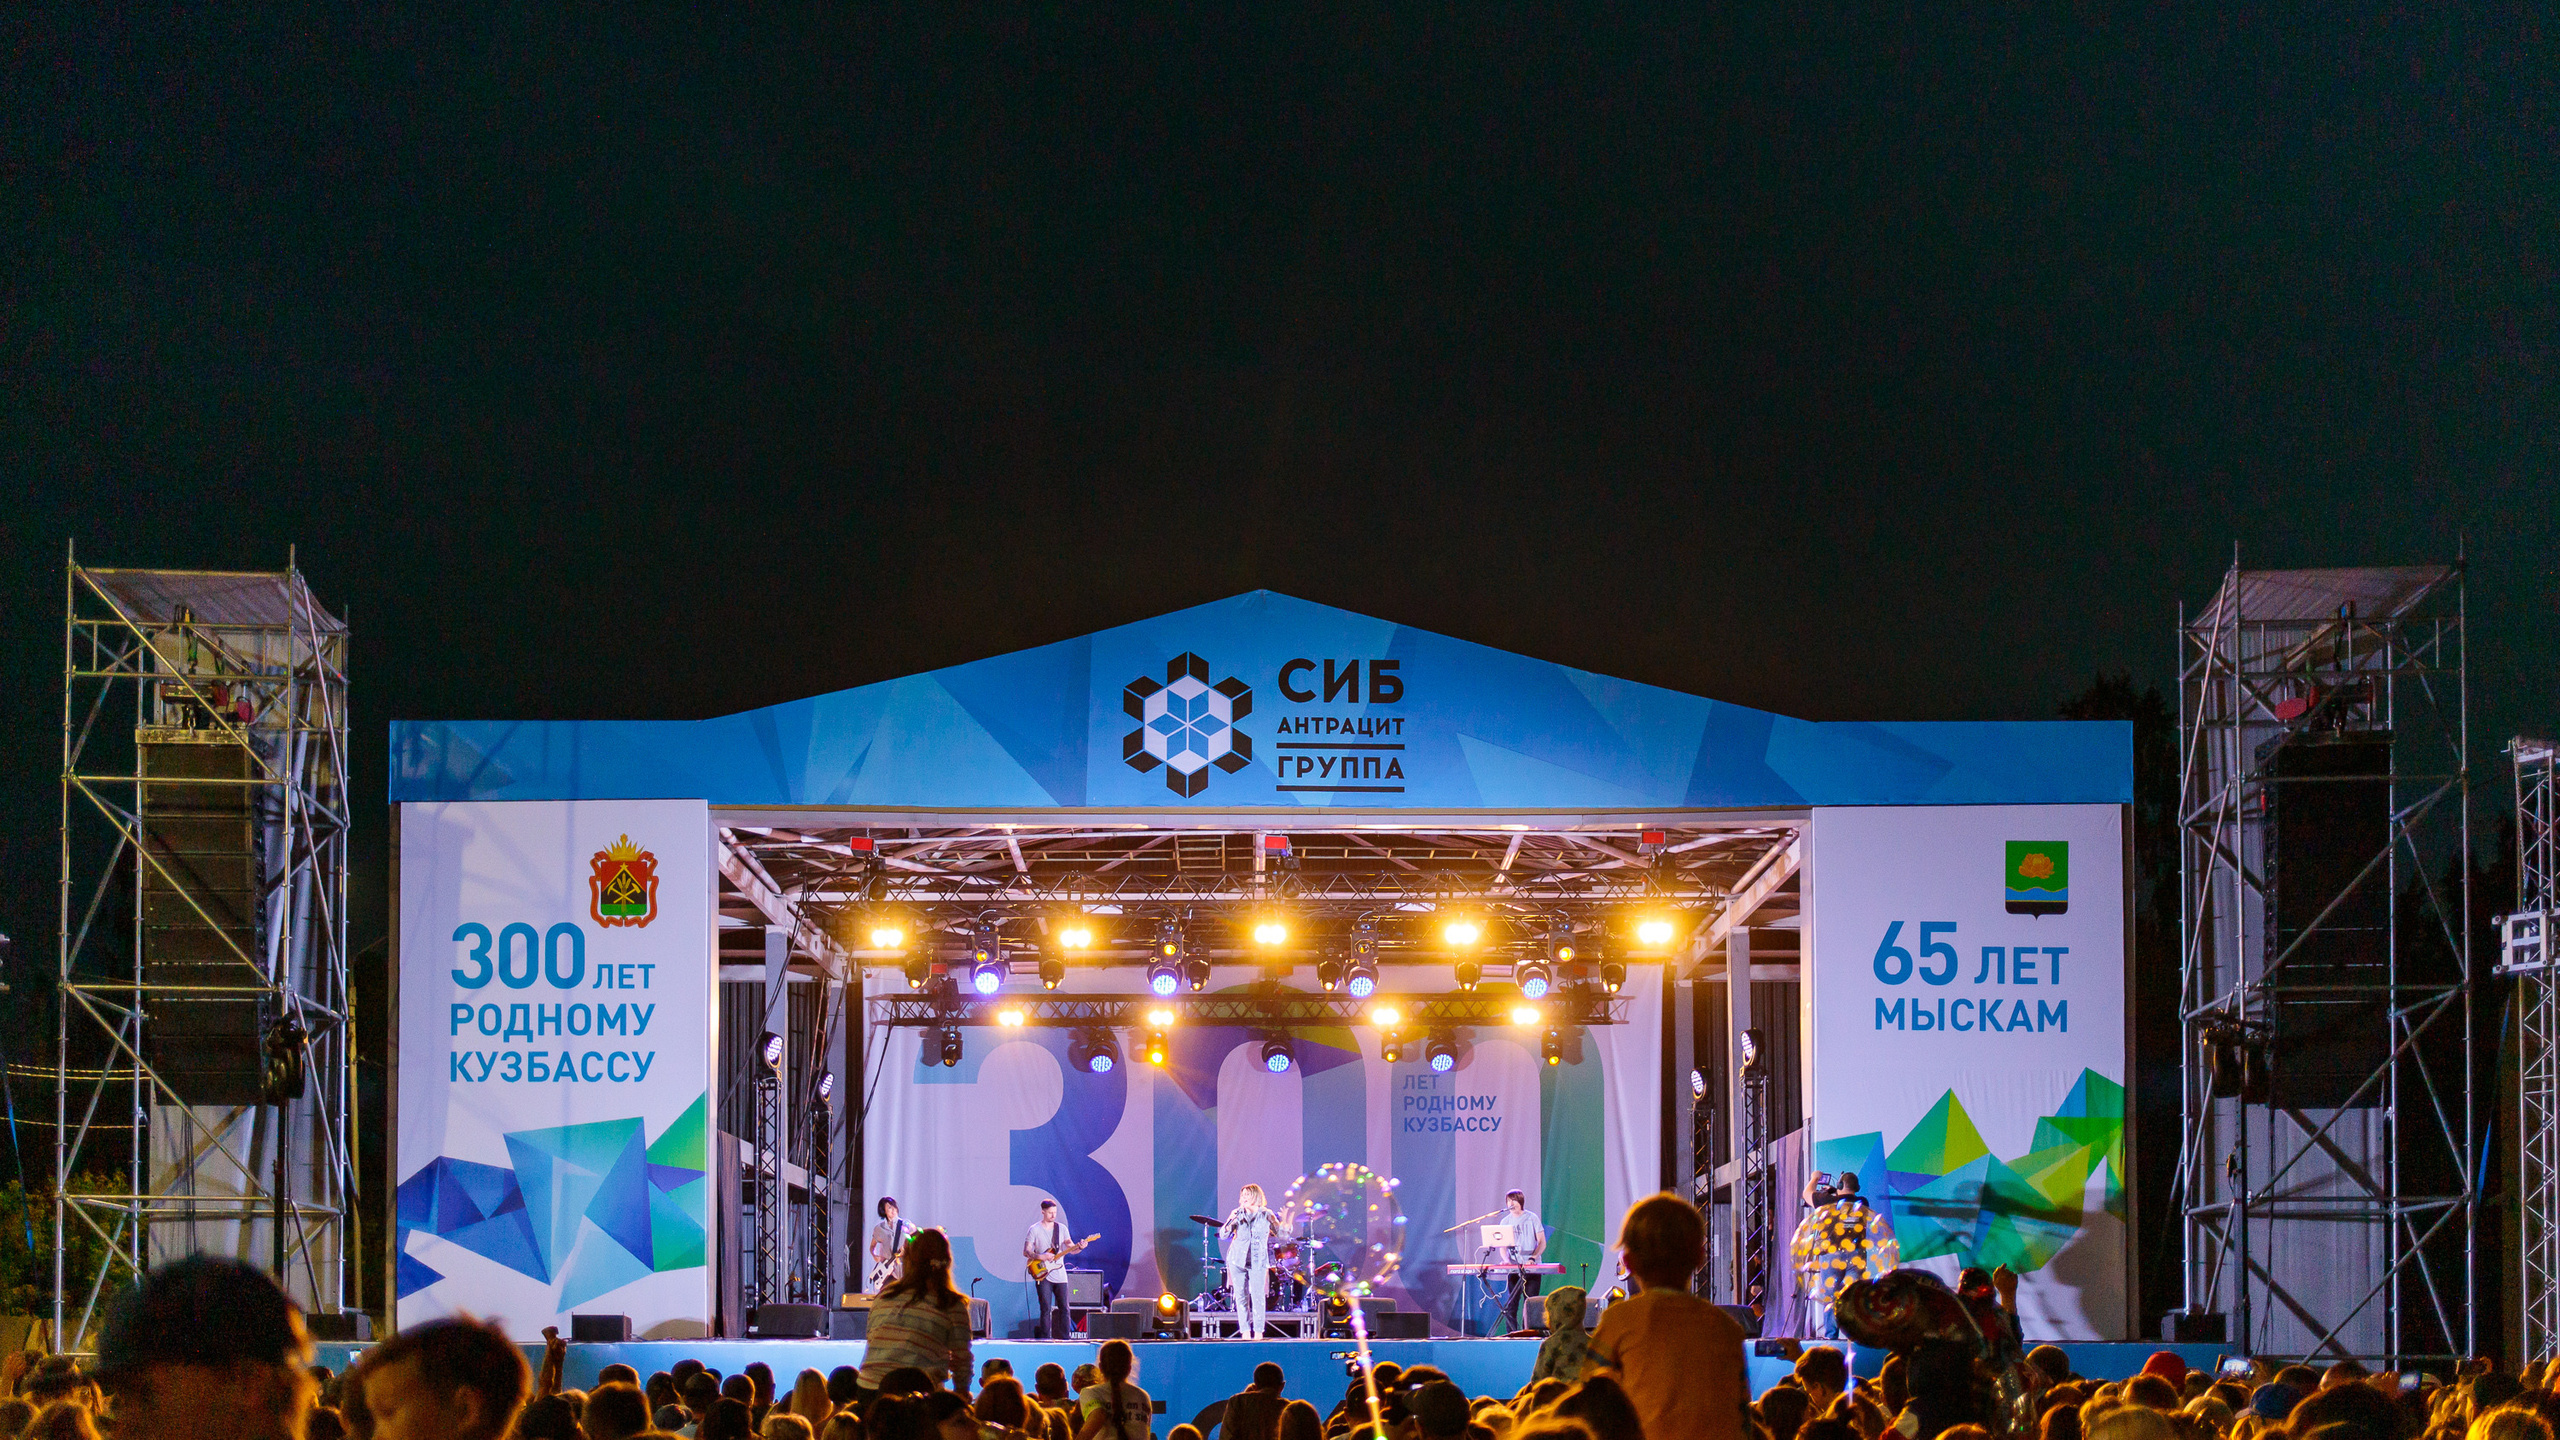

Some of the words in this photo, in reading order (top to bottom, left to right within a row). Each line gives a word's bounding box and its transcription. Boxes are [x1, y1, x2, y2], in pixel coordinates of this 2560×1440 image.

[1278, 658, 1404, 704] СИБ
[1277, 717, 1405, 738] АНТРАЦИТ
[1278, 757, 1405, 779] ГРУППА
[451, 922, 586, 990] 300
[593, 964, 656, 990] ЛЕТ
[1873, 920, 1959, 986] 65
[1974, 947, 2070, 986] ЛЕТ
[450, 1003, 656, 1043] РОДНОМУ
[1875, 998, 2068, 1033] МЫСКАМ
[450, 1051, 656, 1084] КУЗБАССУ
[1403, 1075, 1440, 1090] ЛЕТ
[1403, 1096, 1498, 1114] РОДНОМУ
[1403, 1116, 1502, 1133] КУЗБАССУ
